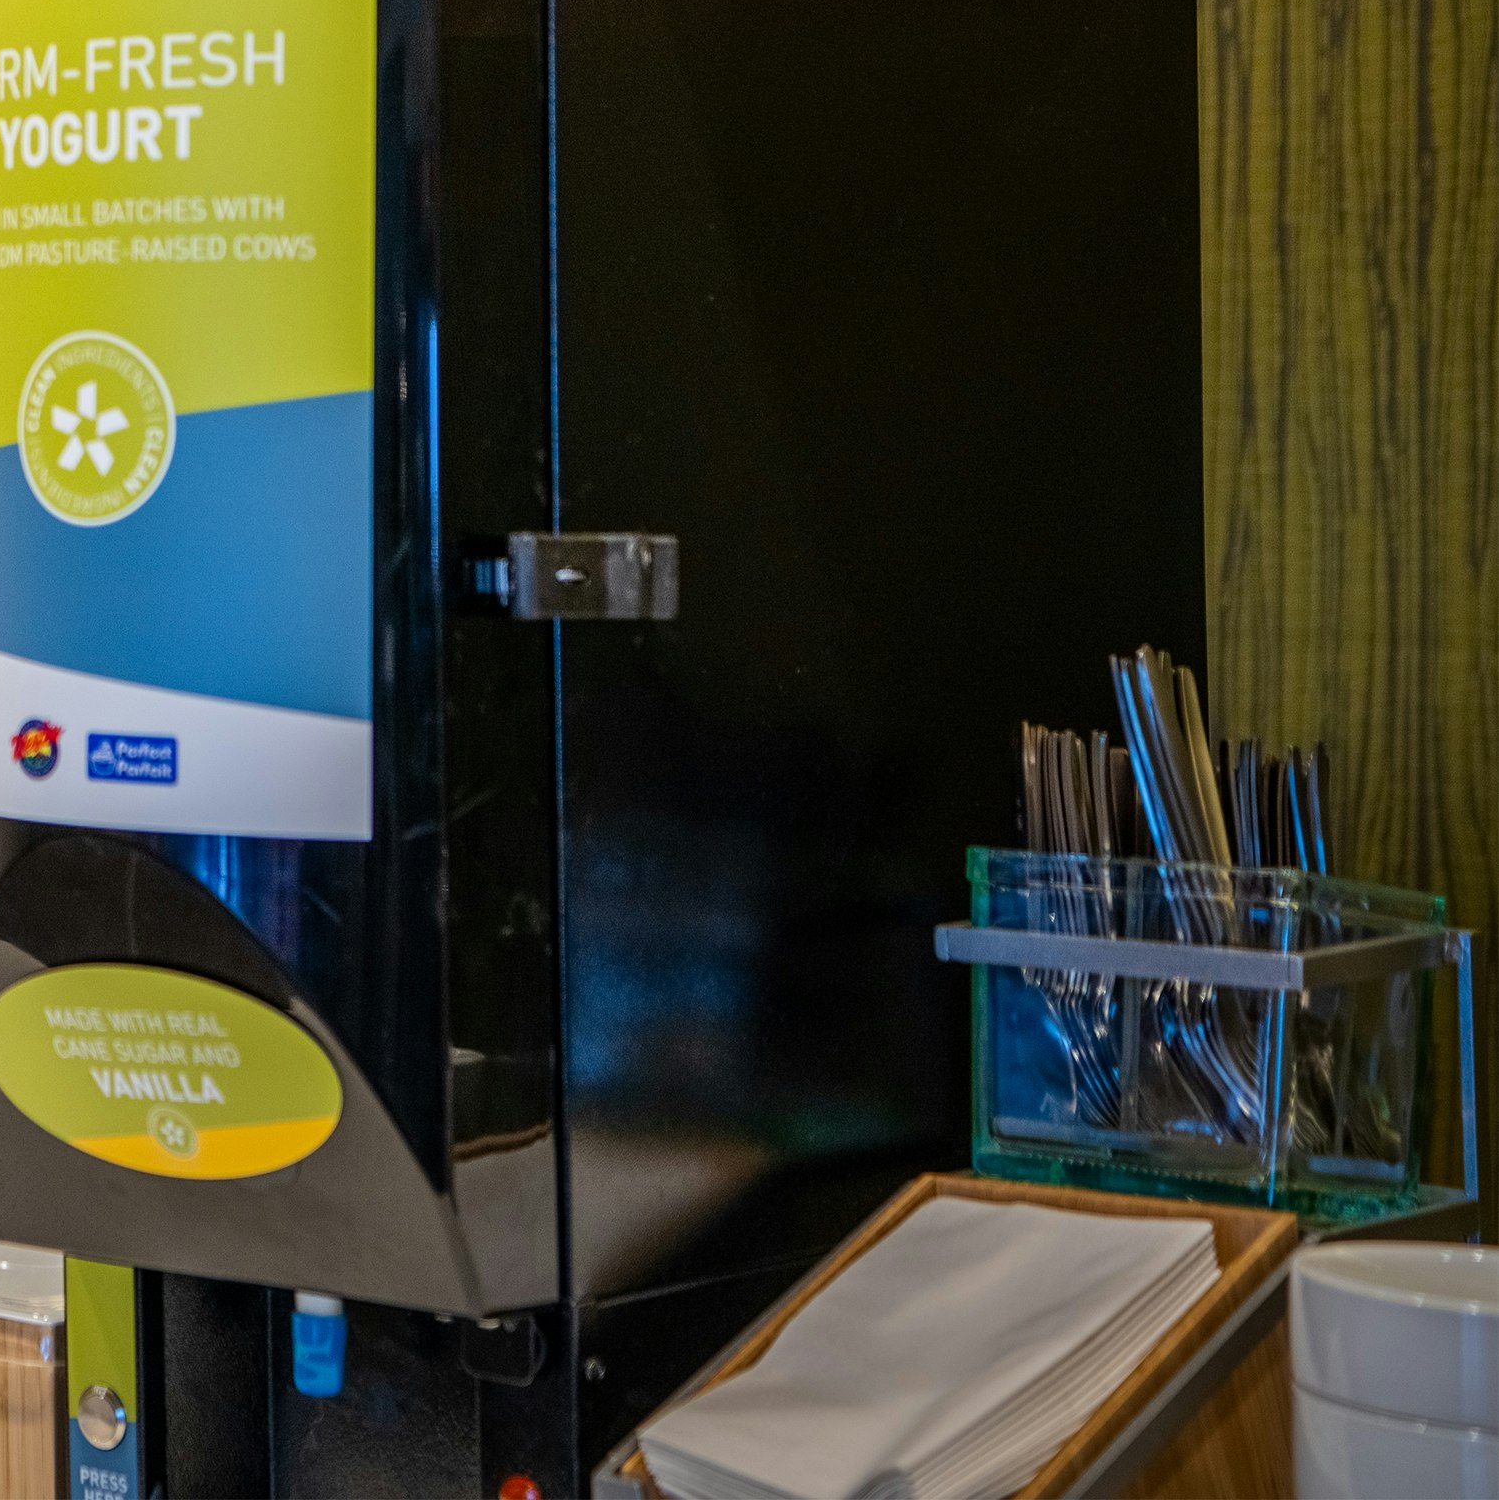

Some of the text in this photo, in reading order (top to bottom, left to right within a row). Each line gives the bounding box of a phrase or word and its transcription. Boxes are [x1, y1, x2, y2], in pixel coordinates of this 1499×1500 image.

[2, 207, 18, 230] IN
[21, 201, 87, 229] SMALL
[91, 197, 207, 226] BATCHES
[211, 196, 285, 222] WITH
[233, 233, 317, 262] COWS
[26, 366, 57, 433] CLEAN
[123, 427, 165, 495] CLEAN
[44, 1006, 228, 1037] MADE WITH REAL
[53, 1034, 241, 1069] CANE SUGAR AND
[90, 1066, 226, 1105] VANILLA
[79, 1465, 128, 1495] PRESS
